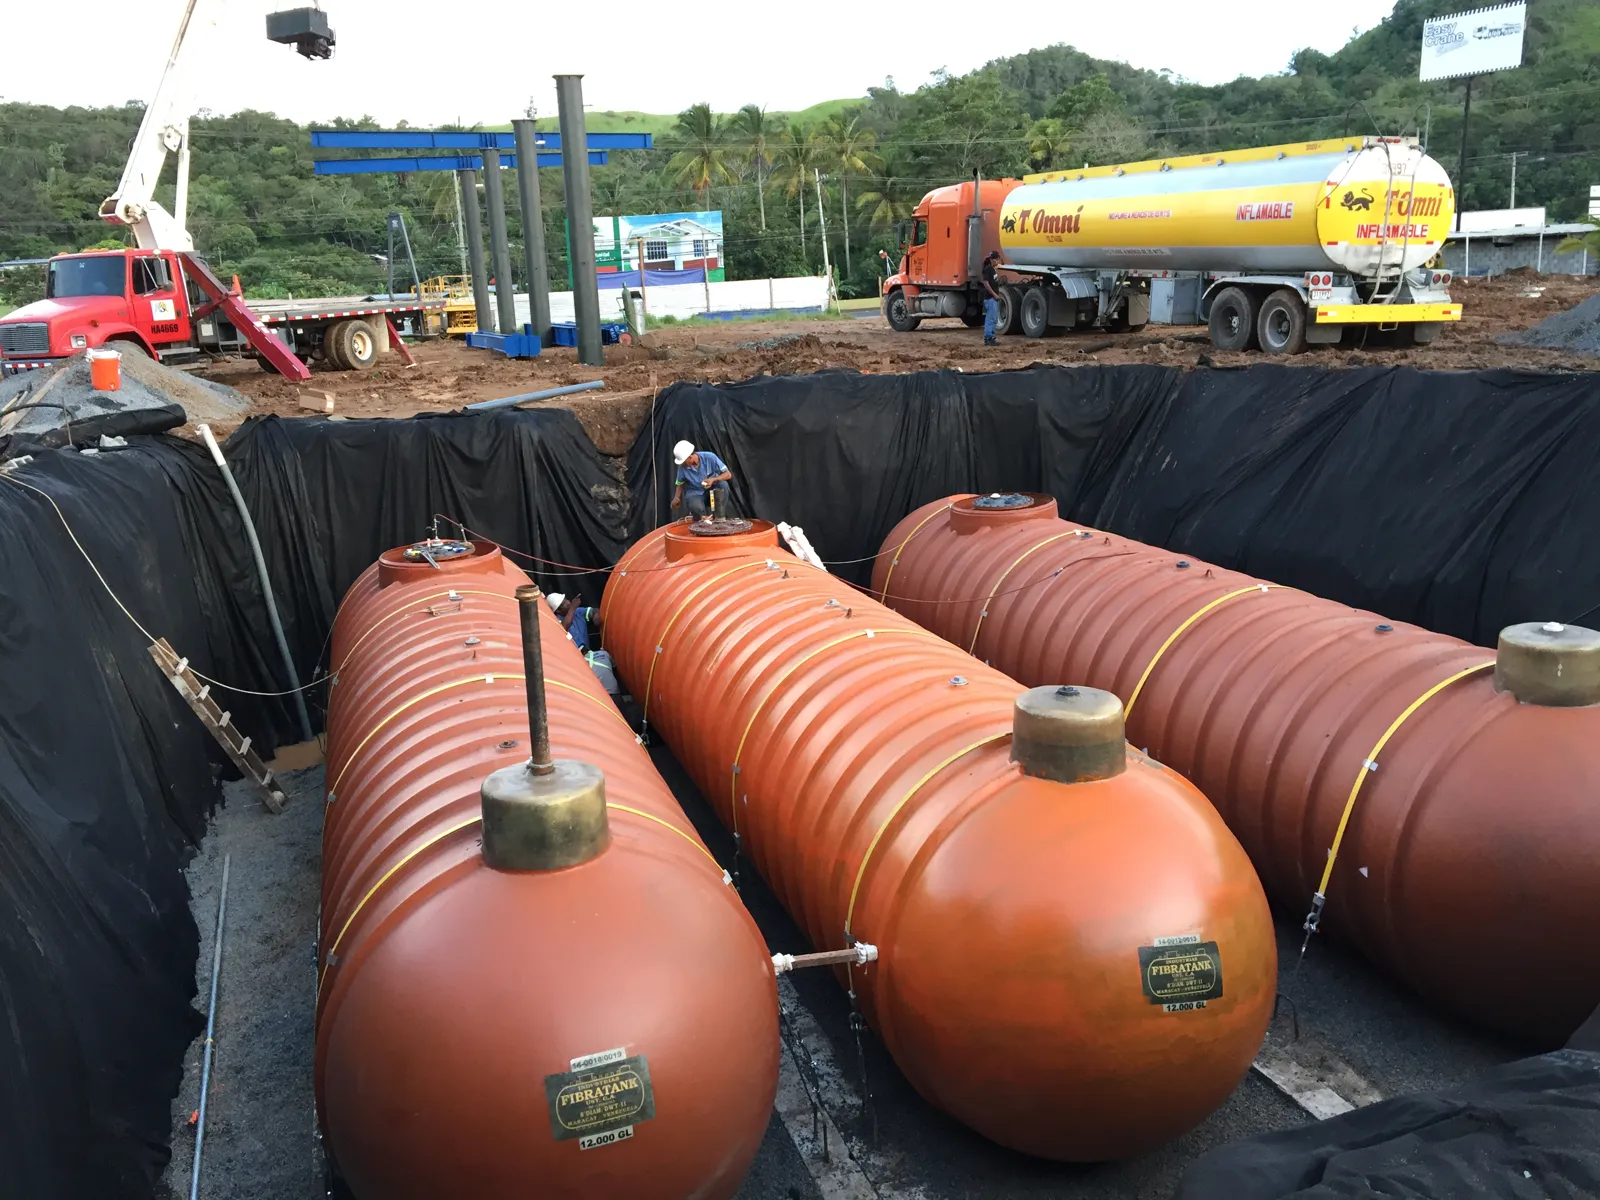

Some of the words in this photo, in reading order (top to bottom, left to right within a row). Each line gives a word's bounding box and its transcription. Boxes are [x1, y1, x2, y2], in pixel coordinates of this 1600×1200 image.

[1424, 22, 1458, 37] Easy
[1425, 32, 1465, 47] Crane
[1236, 203, 1293, 220] INFLAMABLE
[1398, 191, 1443, 217] Omni
[1019, 209, 1032, 234] T.
[1033, 205, 1084, 234] Omni
[1356, 224, 1428, 238] INFLAMABLE
[151, 324, 178, 333] HA4669
[1152, 960, 1211, 975] FIBRATANK
[1166, 1002, 1194, 1012] 12.000
[1196, 1001, 1206, 1009] GL
[578, 1077, 620, 1090] INDUSTRIAS
[561, 1078, 639, 1106] FIBRATANK
[580, 1132, 615, 1149] 12.000
[618, 1129, 632, 1139] GL
